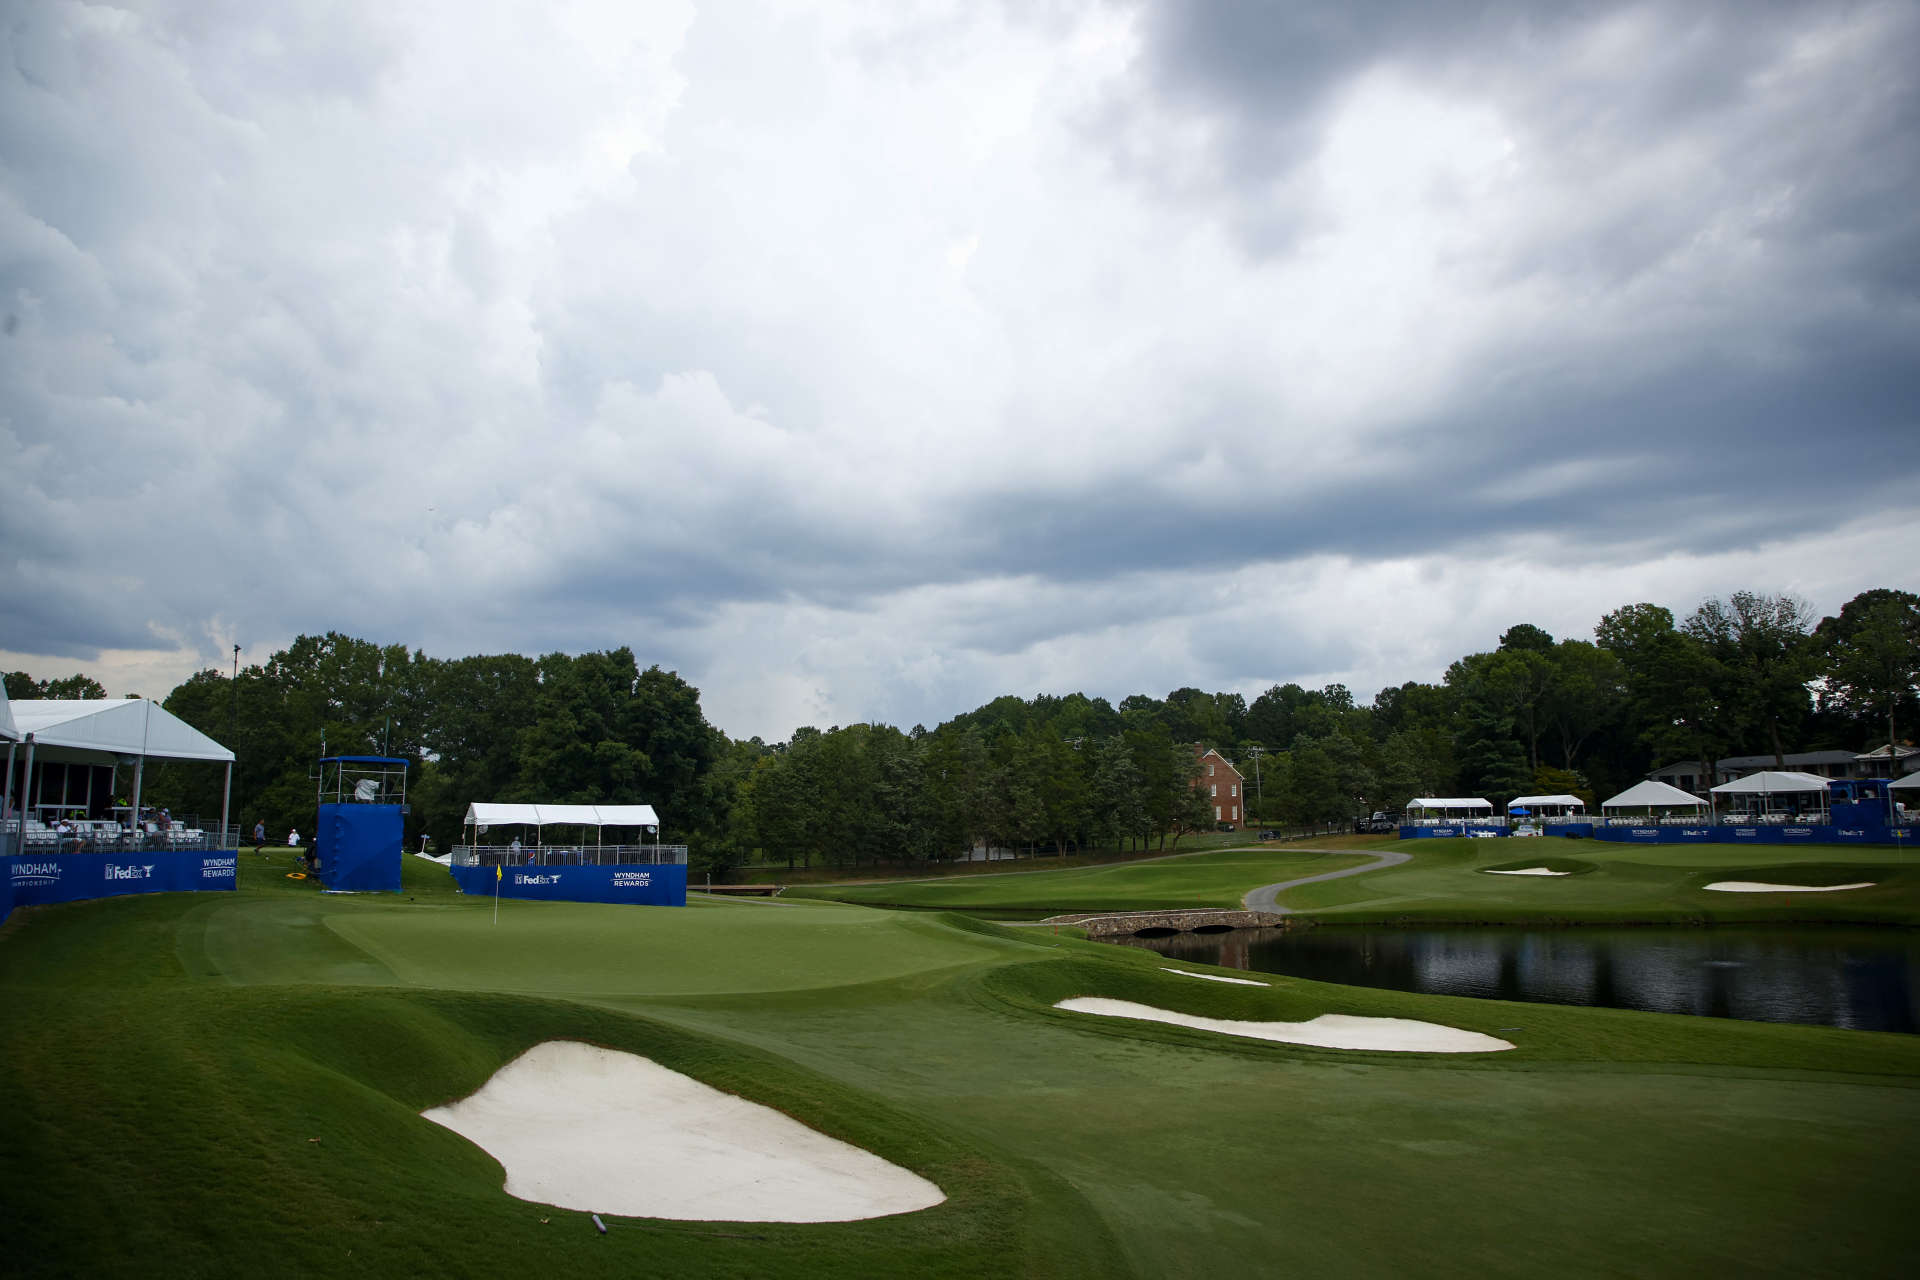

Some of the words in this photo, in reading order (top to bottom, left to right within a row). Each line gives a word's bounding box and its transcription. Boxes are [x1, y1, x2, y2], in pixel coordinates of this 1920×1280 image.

[203, 858, 235, 867] WYNDHAM
[114, 865, 143, 879] FedEx
[203, 869, 235, 878] REWARDS
[523, 874, 550, 885] FedEx
